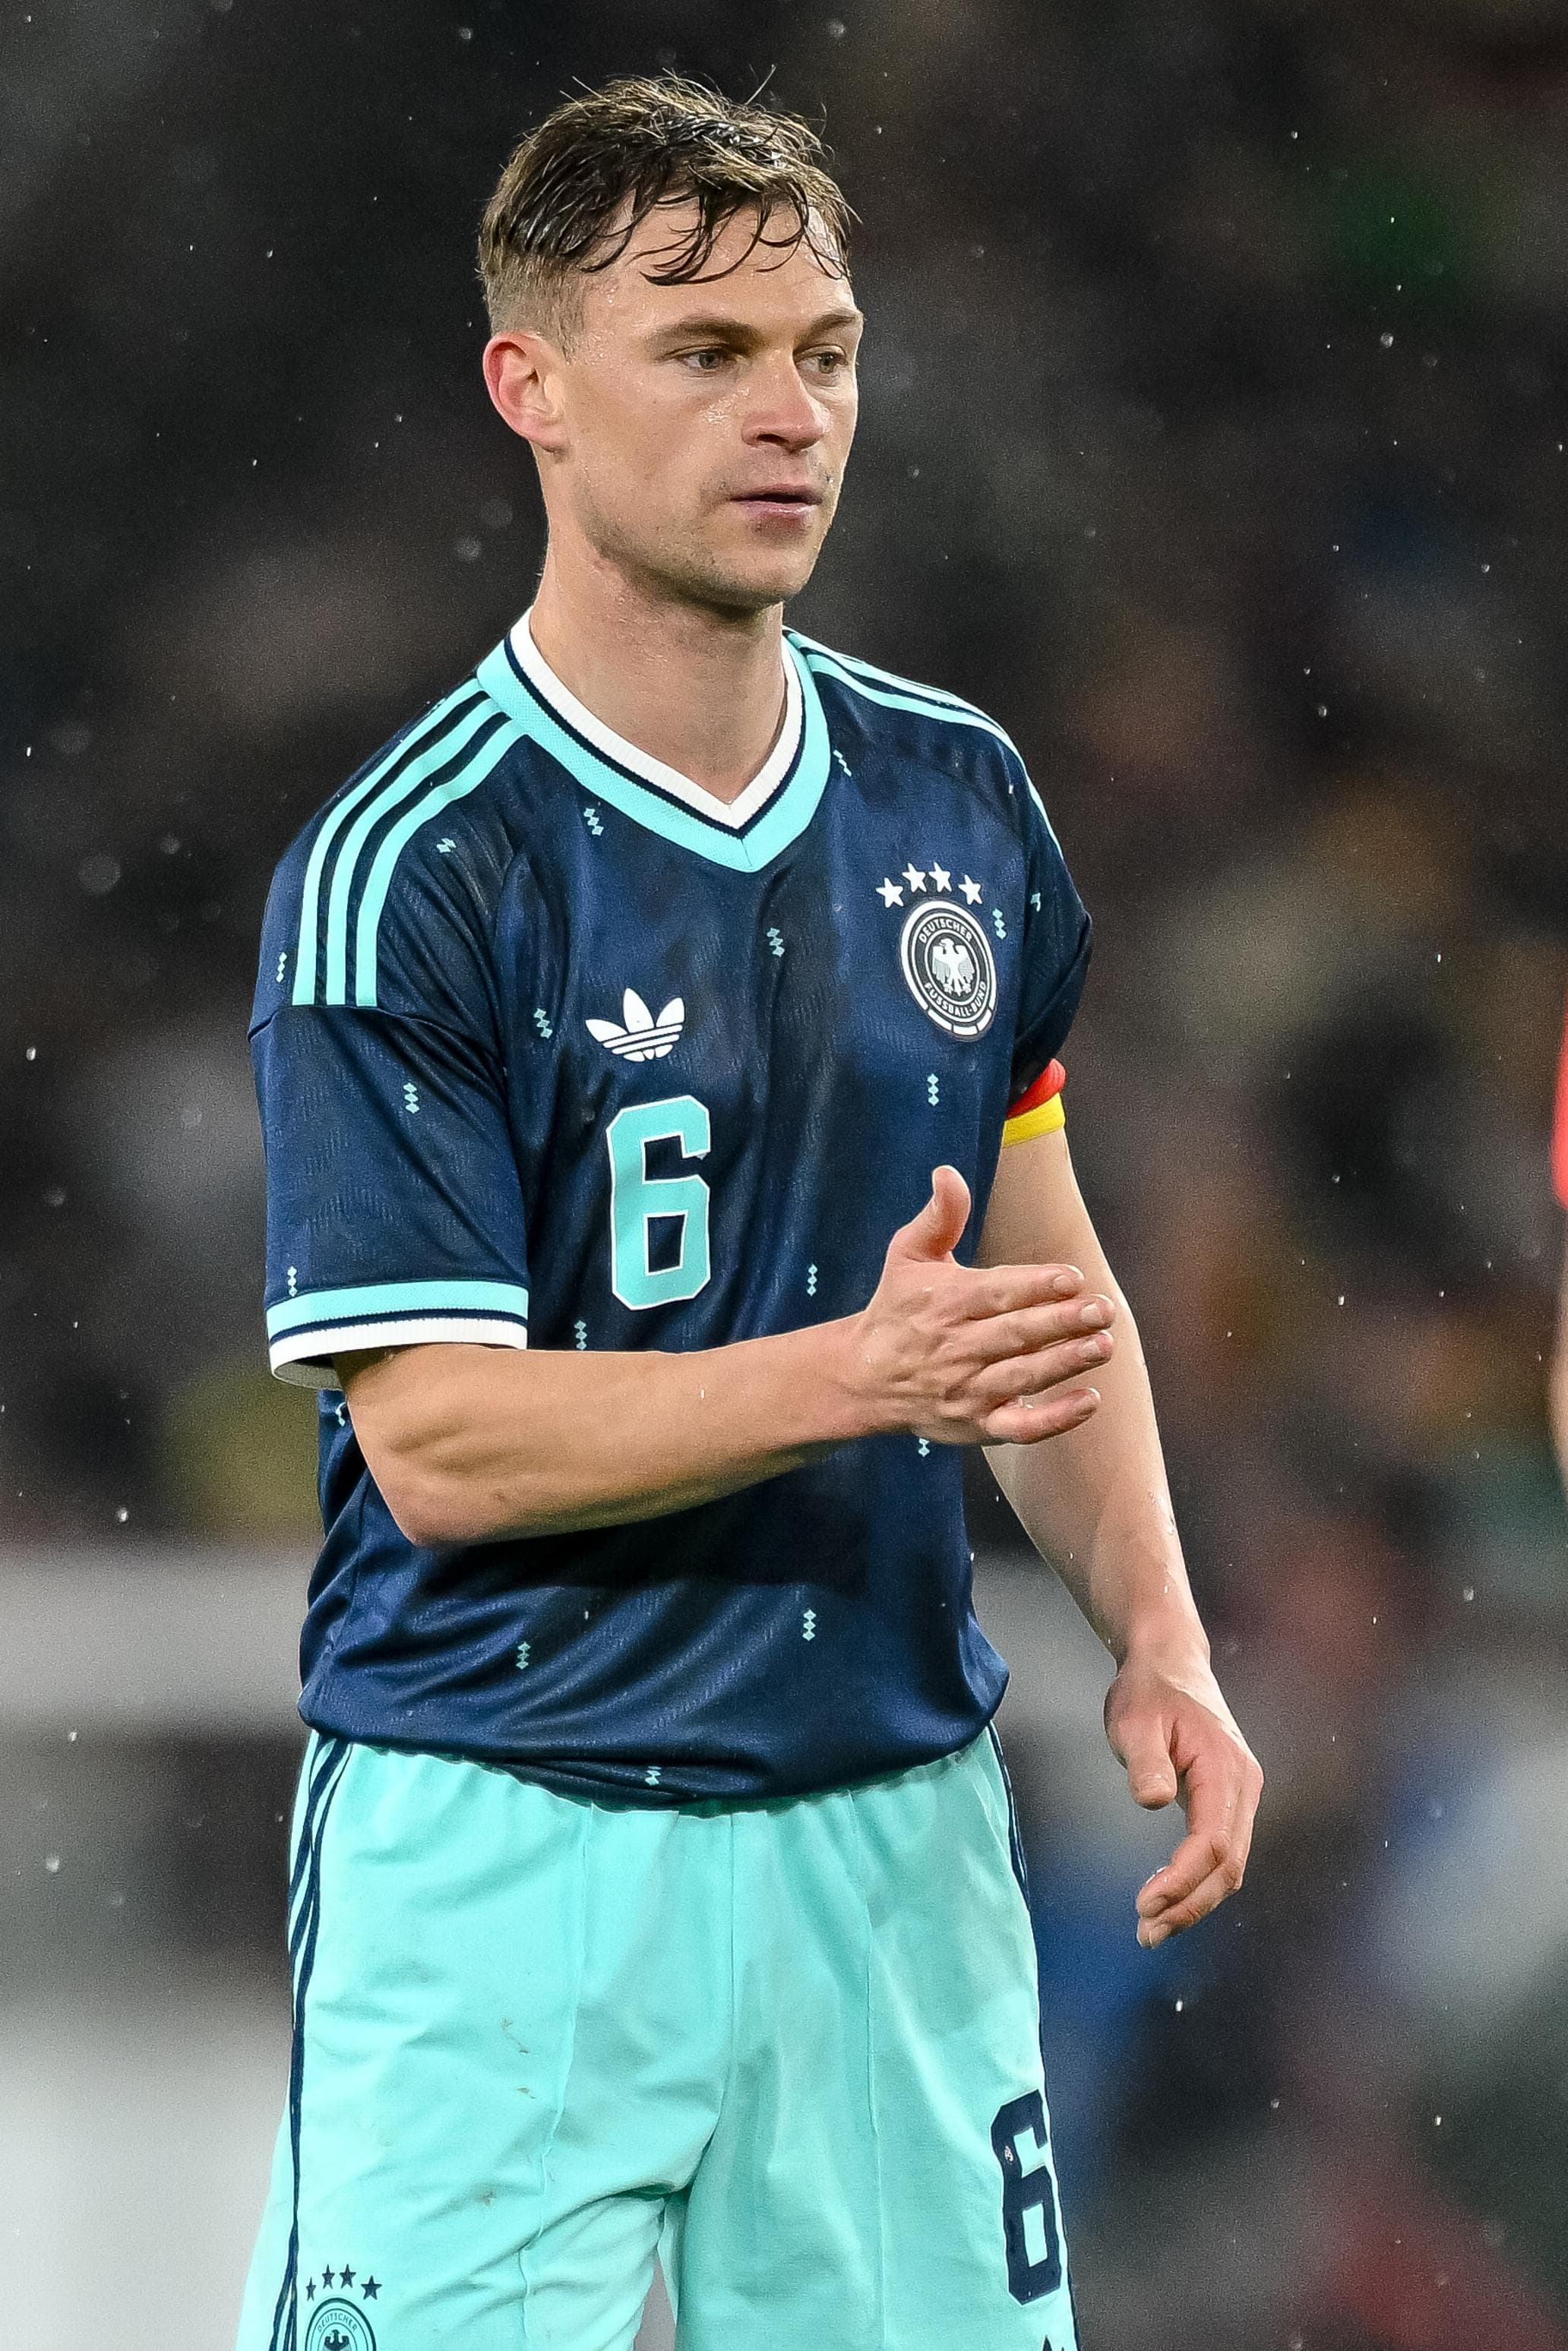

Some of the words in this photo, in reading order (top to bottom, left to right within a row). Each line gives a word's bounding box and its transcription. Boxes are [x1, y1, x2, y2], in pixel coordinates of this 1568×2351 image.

[919, 918, 972, 943] DEUTSCHER
[606, 1095, 710, 1311] 6
[991, 2089, 1061, 2305] 6
[318, 2313, 358, 2333] DEUTSCHER
